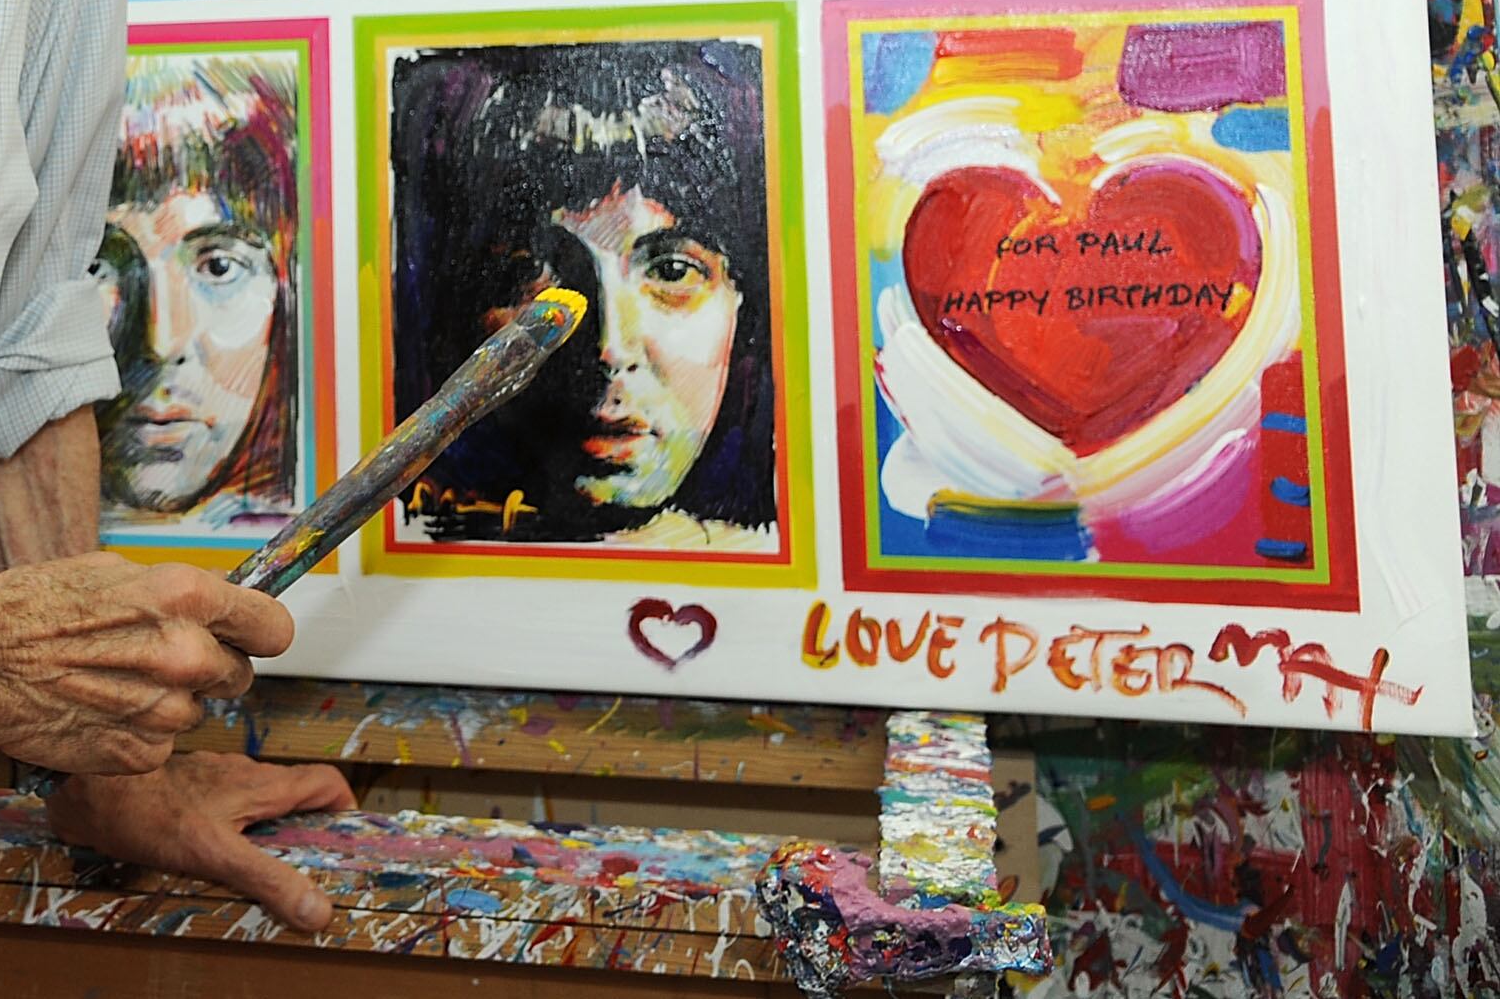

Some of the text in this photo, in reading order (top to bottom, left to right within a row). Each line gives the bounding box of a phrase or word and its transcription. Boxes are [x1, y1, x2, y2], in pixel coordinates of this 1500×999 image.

[995, 229, 1173, 259] FOR PAUL
[943, 281, 1235, 315] HAPPY BIRTHDAY
[801, 598, 965, 680] LOVE
[979, 614, 1247, 719] PETER
